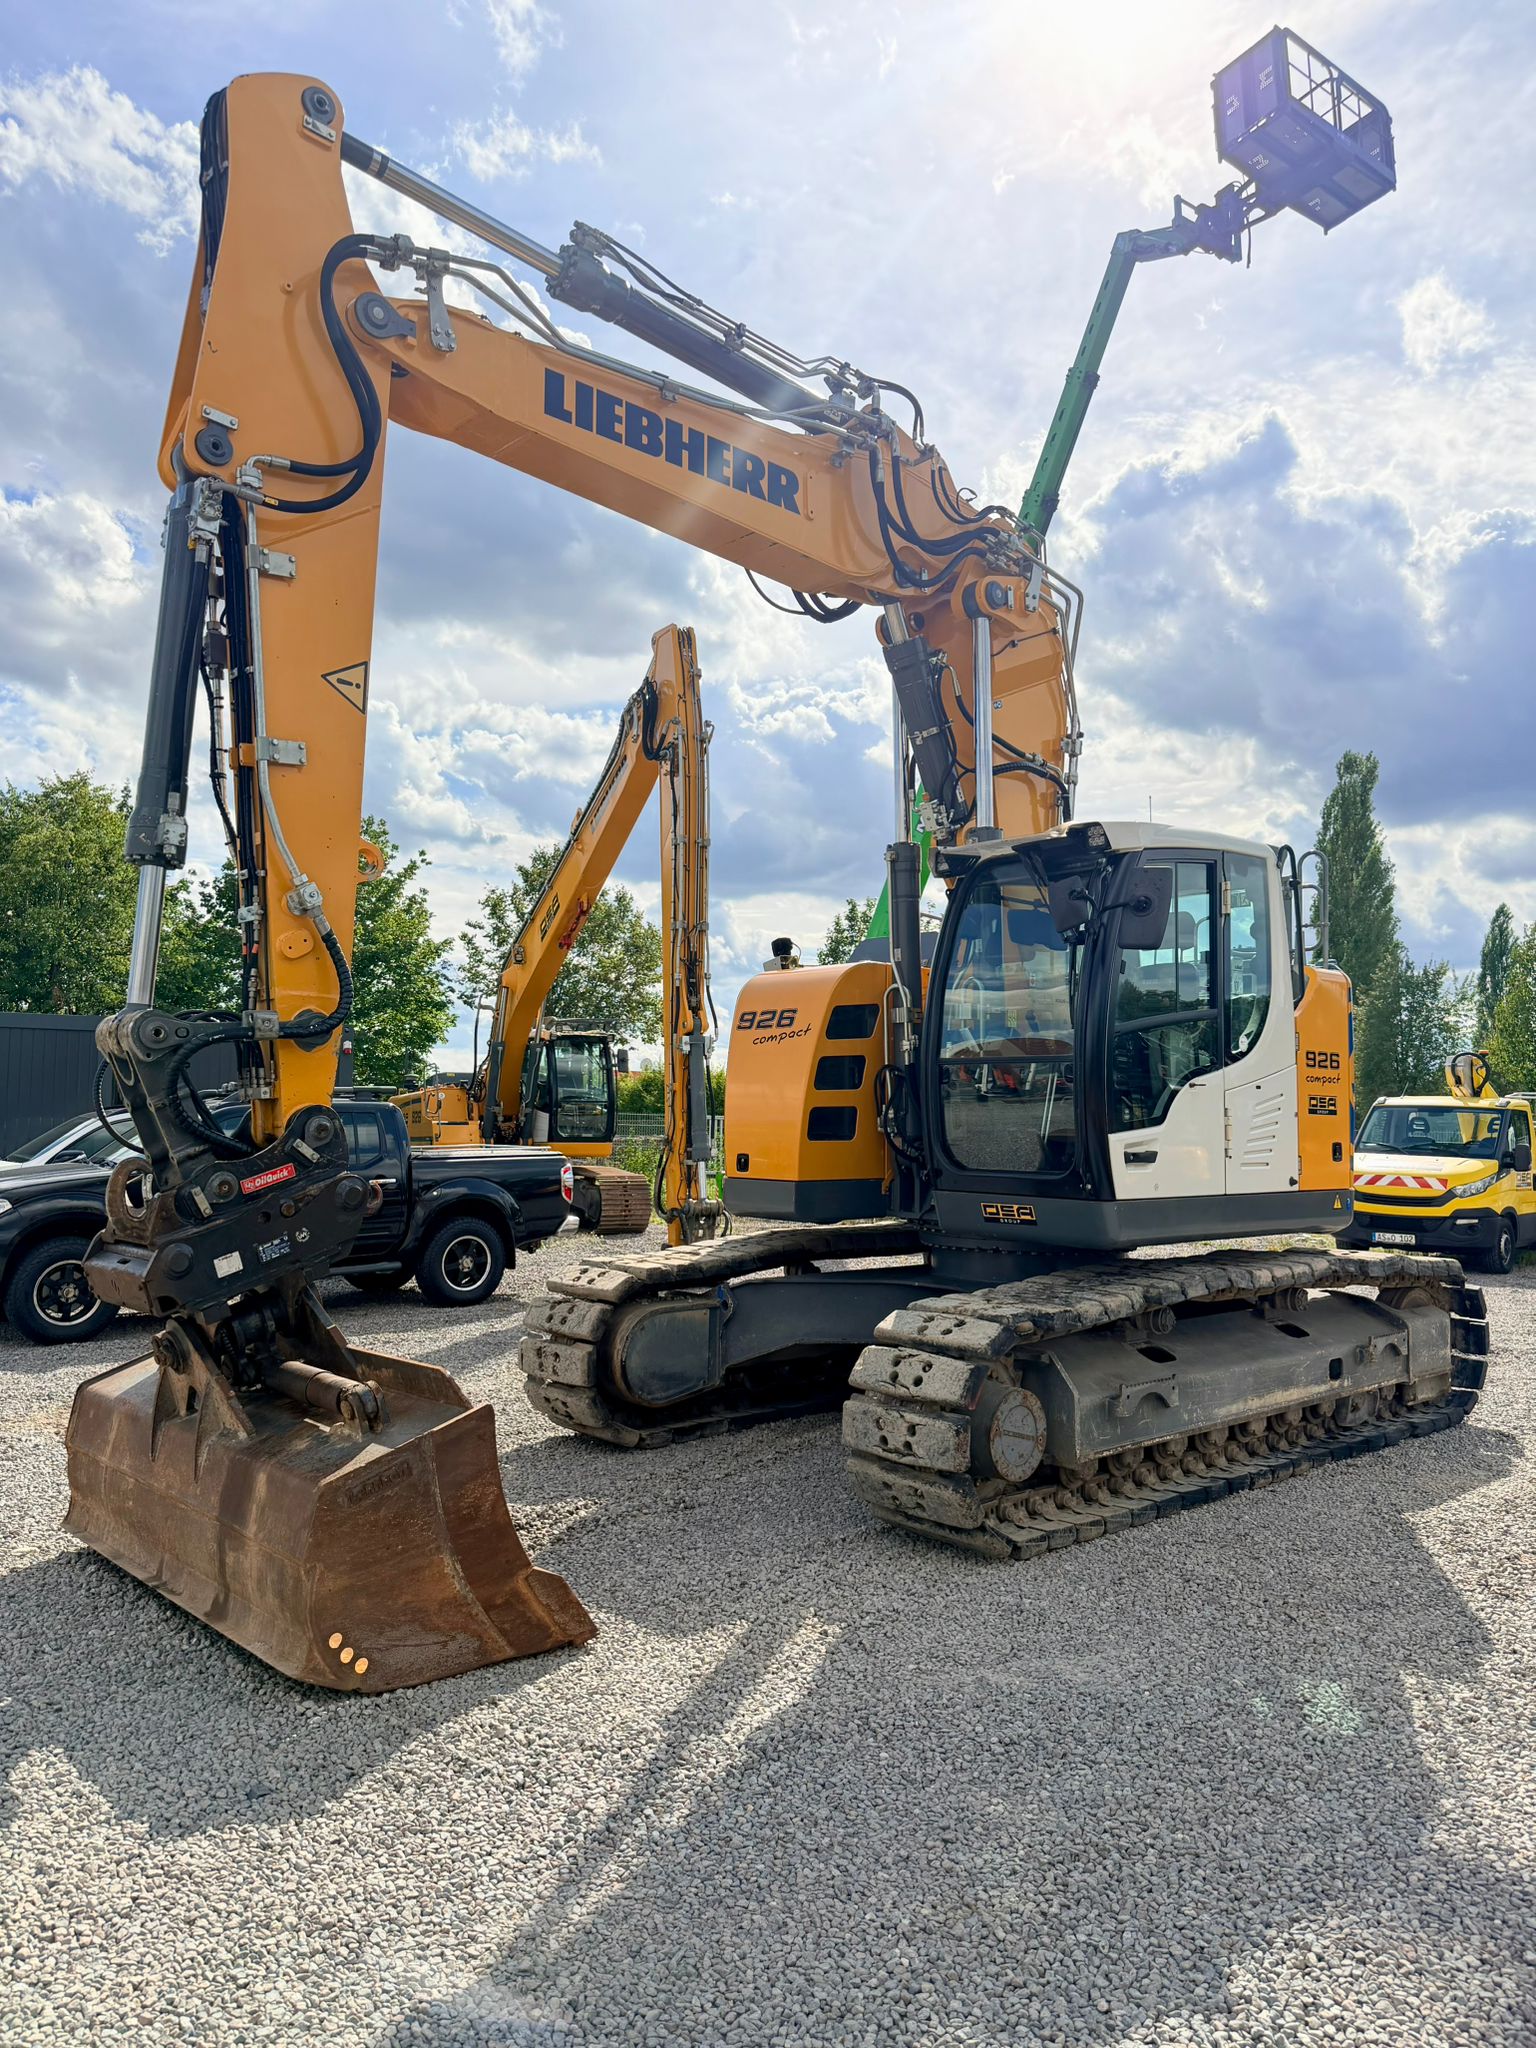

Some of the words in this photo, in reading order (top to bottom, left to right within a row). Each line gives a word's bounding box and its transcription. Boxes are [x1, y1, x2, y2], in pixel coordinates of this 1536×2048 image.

[544, 368, 801, 515] LIEBHERR
[737, 1008, 799, 1031] 926
[753, 1023, 811, 1045] compact
[1306, 1050, 1340, 1069] 926
[1305, 1073, 1341, 1086] compact
